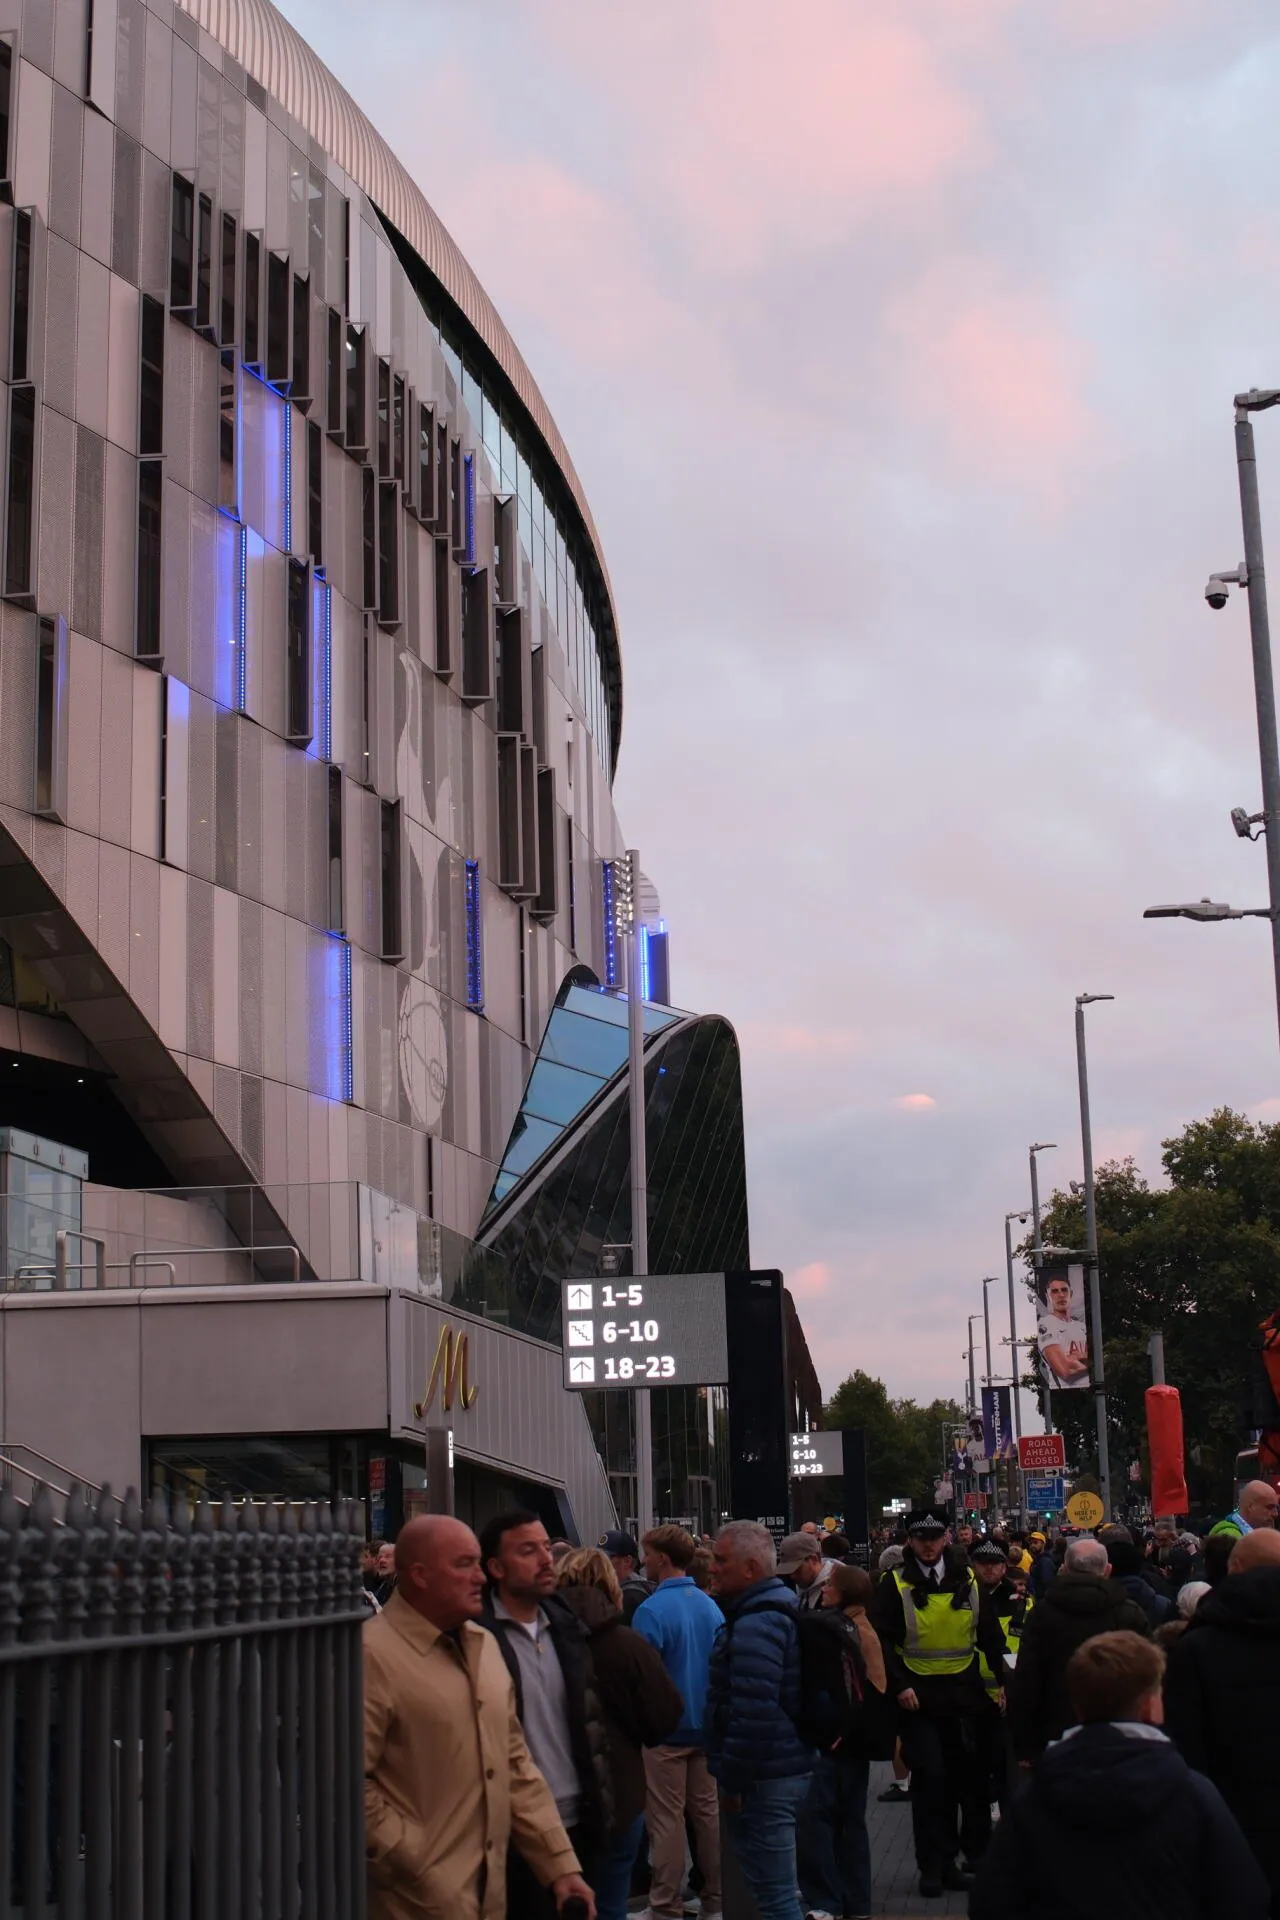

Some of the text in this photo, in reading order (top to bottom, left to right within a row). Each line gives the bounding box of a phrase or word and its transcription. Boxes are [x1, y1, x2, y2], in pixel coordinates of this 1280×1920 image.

[602, 1285, 643, 1307] 1-5
[603, 1320, 659, 1343] 6-10
[604, 1356, 676, 1380] 18-23
[992, 1391, 1002, 1450] TOTTENHAM
[792, 1435, 810, 1445] 1-5
[1028, 1439, 1053, 1448] ROAD
[792, 1449, 817, 1460] 6-10
[1026, 1447, 1057, 1457] AHEAD
[1024, 1456, 1060, 1465] CLOSED
[793, 1463, 824, 1475] 18-23
